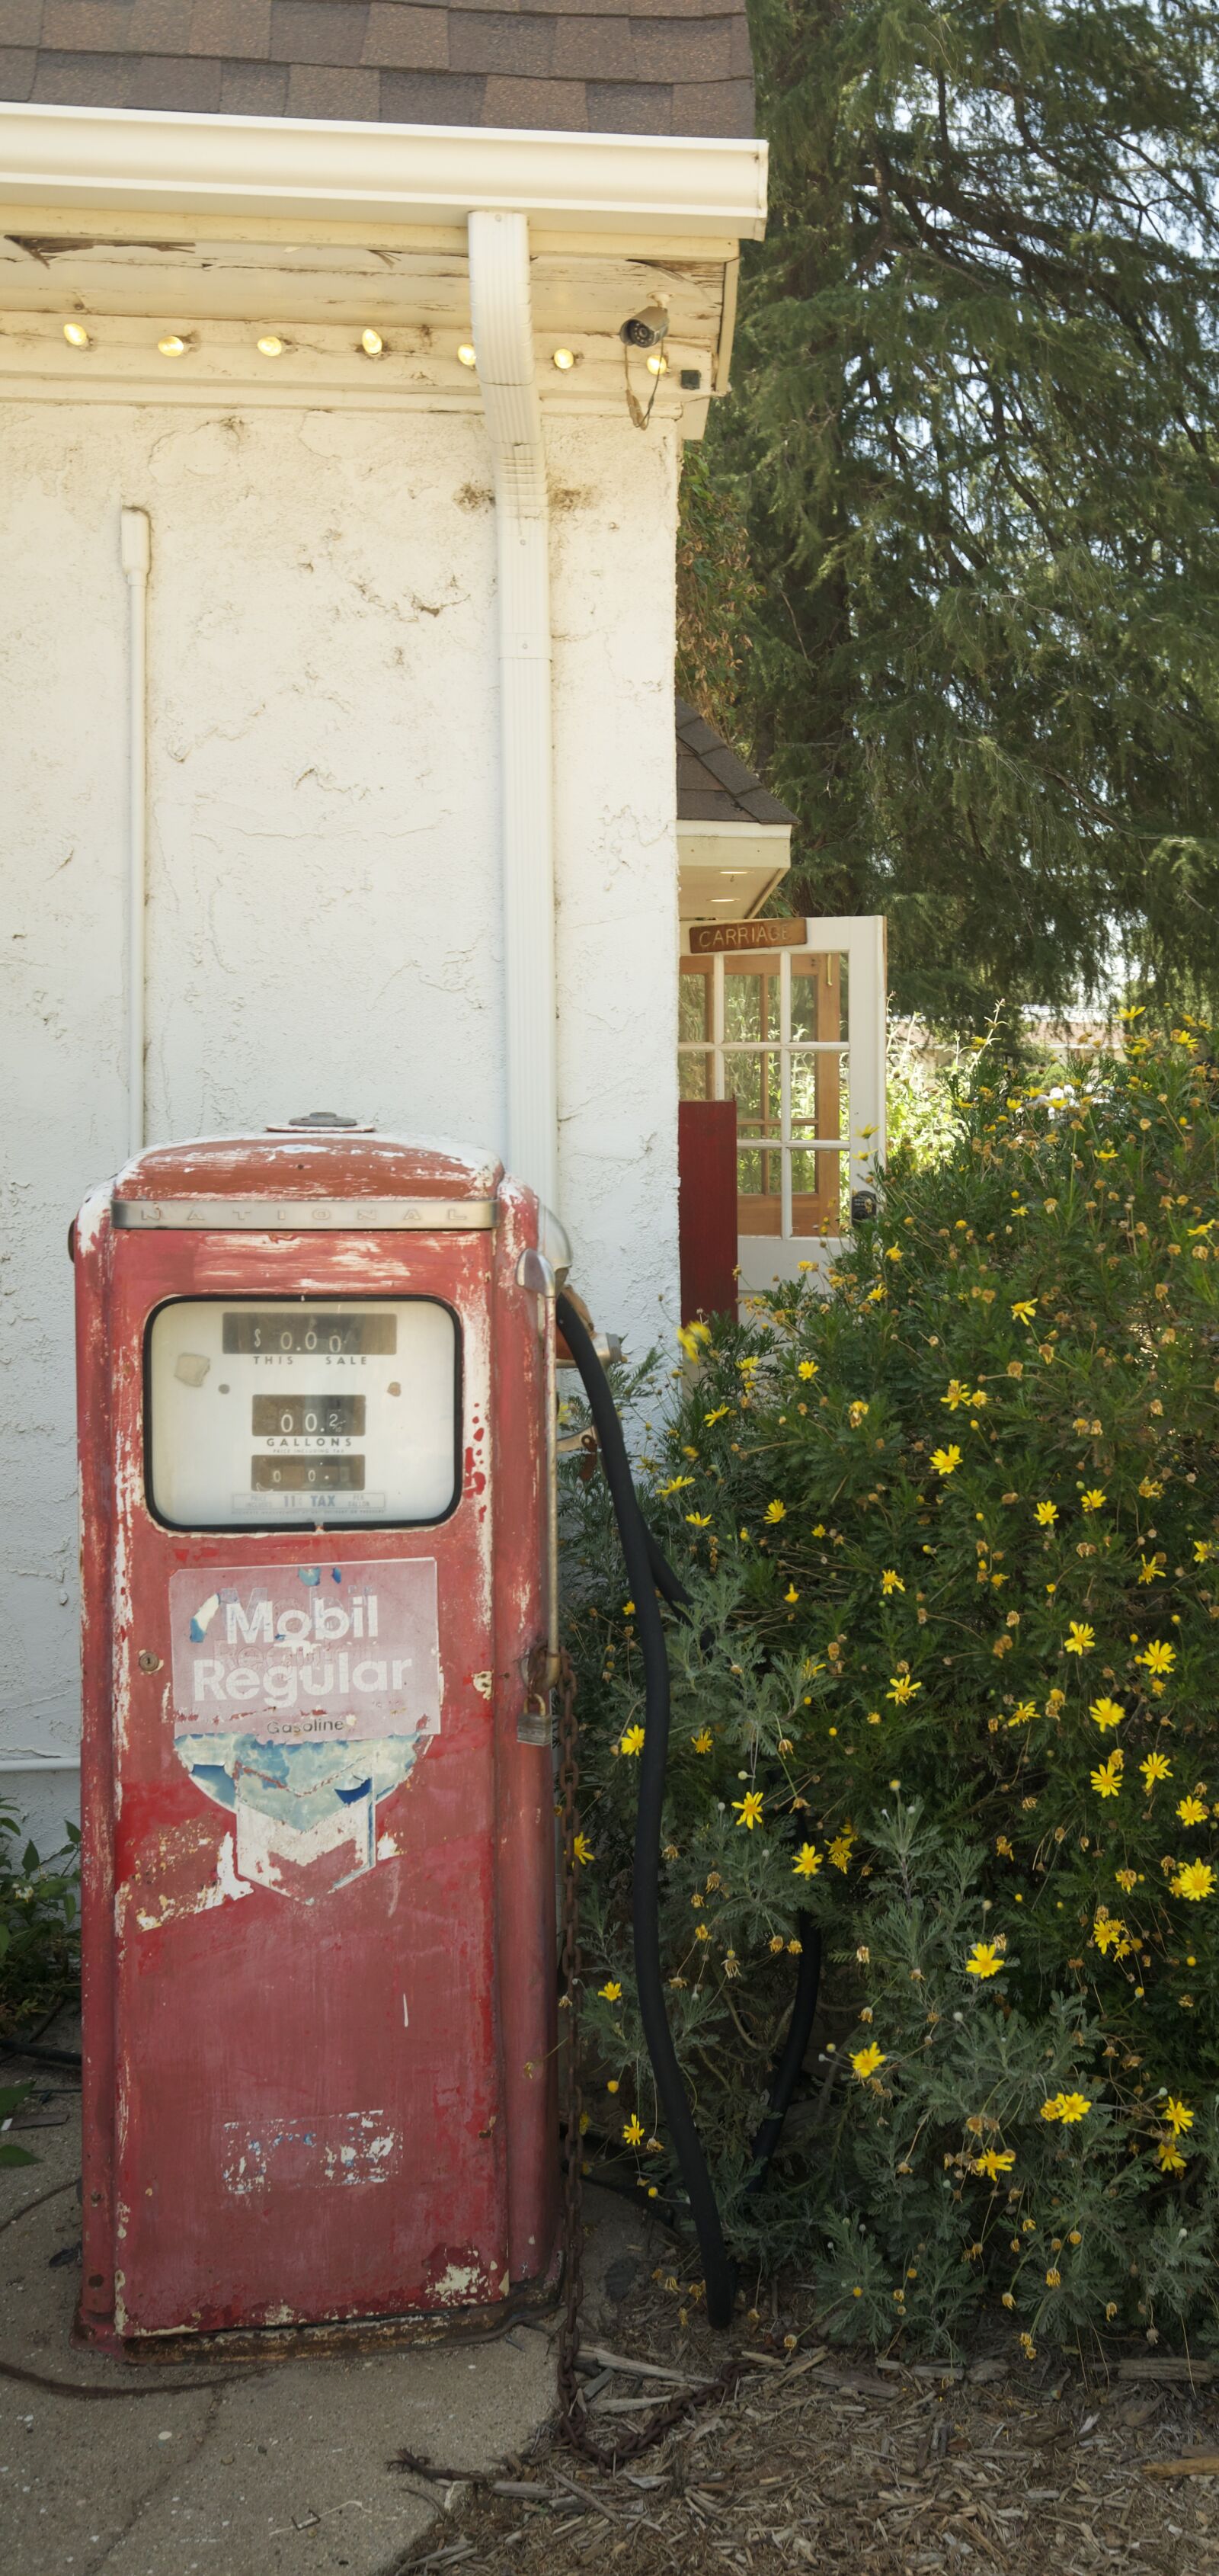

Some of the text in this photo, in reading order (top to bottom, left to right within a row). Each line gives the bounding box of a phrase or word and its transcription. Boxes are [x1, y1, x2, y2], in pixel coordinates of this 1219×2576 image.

[699, 924, 789, 947] CARRIAGE
[141, 1209, 468, 1221] NATIONAL
[253, 1356, 367, 1365] THIS SALE
[267, 1437, 352, 1447] GALLONS
[310, 1495, 336, 1507] TAX
[226, 1594, 379, 1645] Mobil
[193, 1653, 413, 1709] Regular
[267, 1718, 345, 1735] Gasoline
